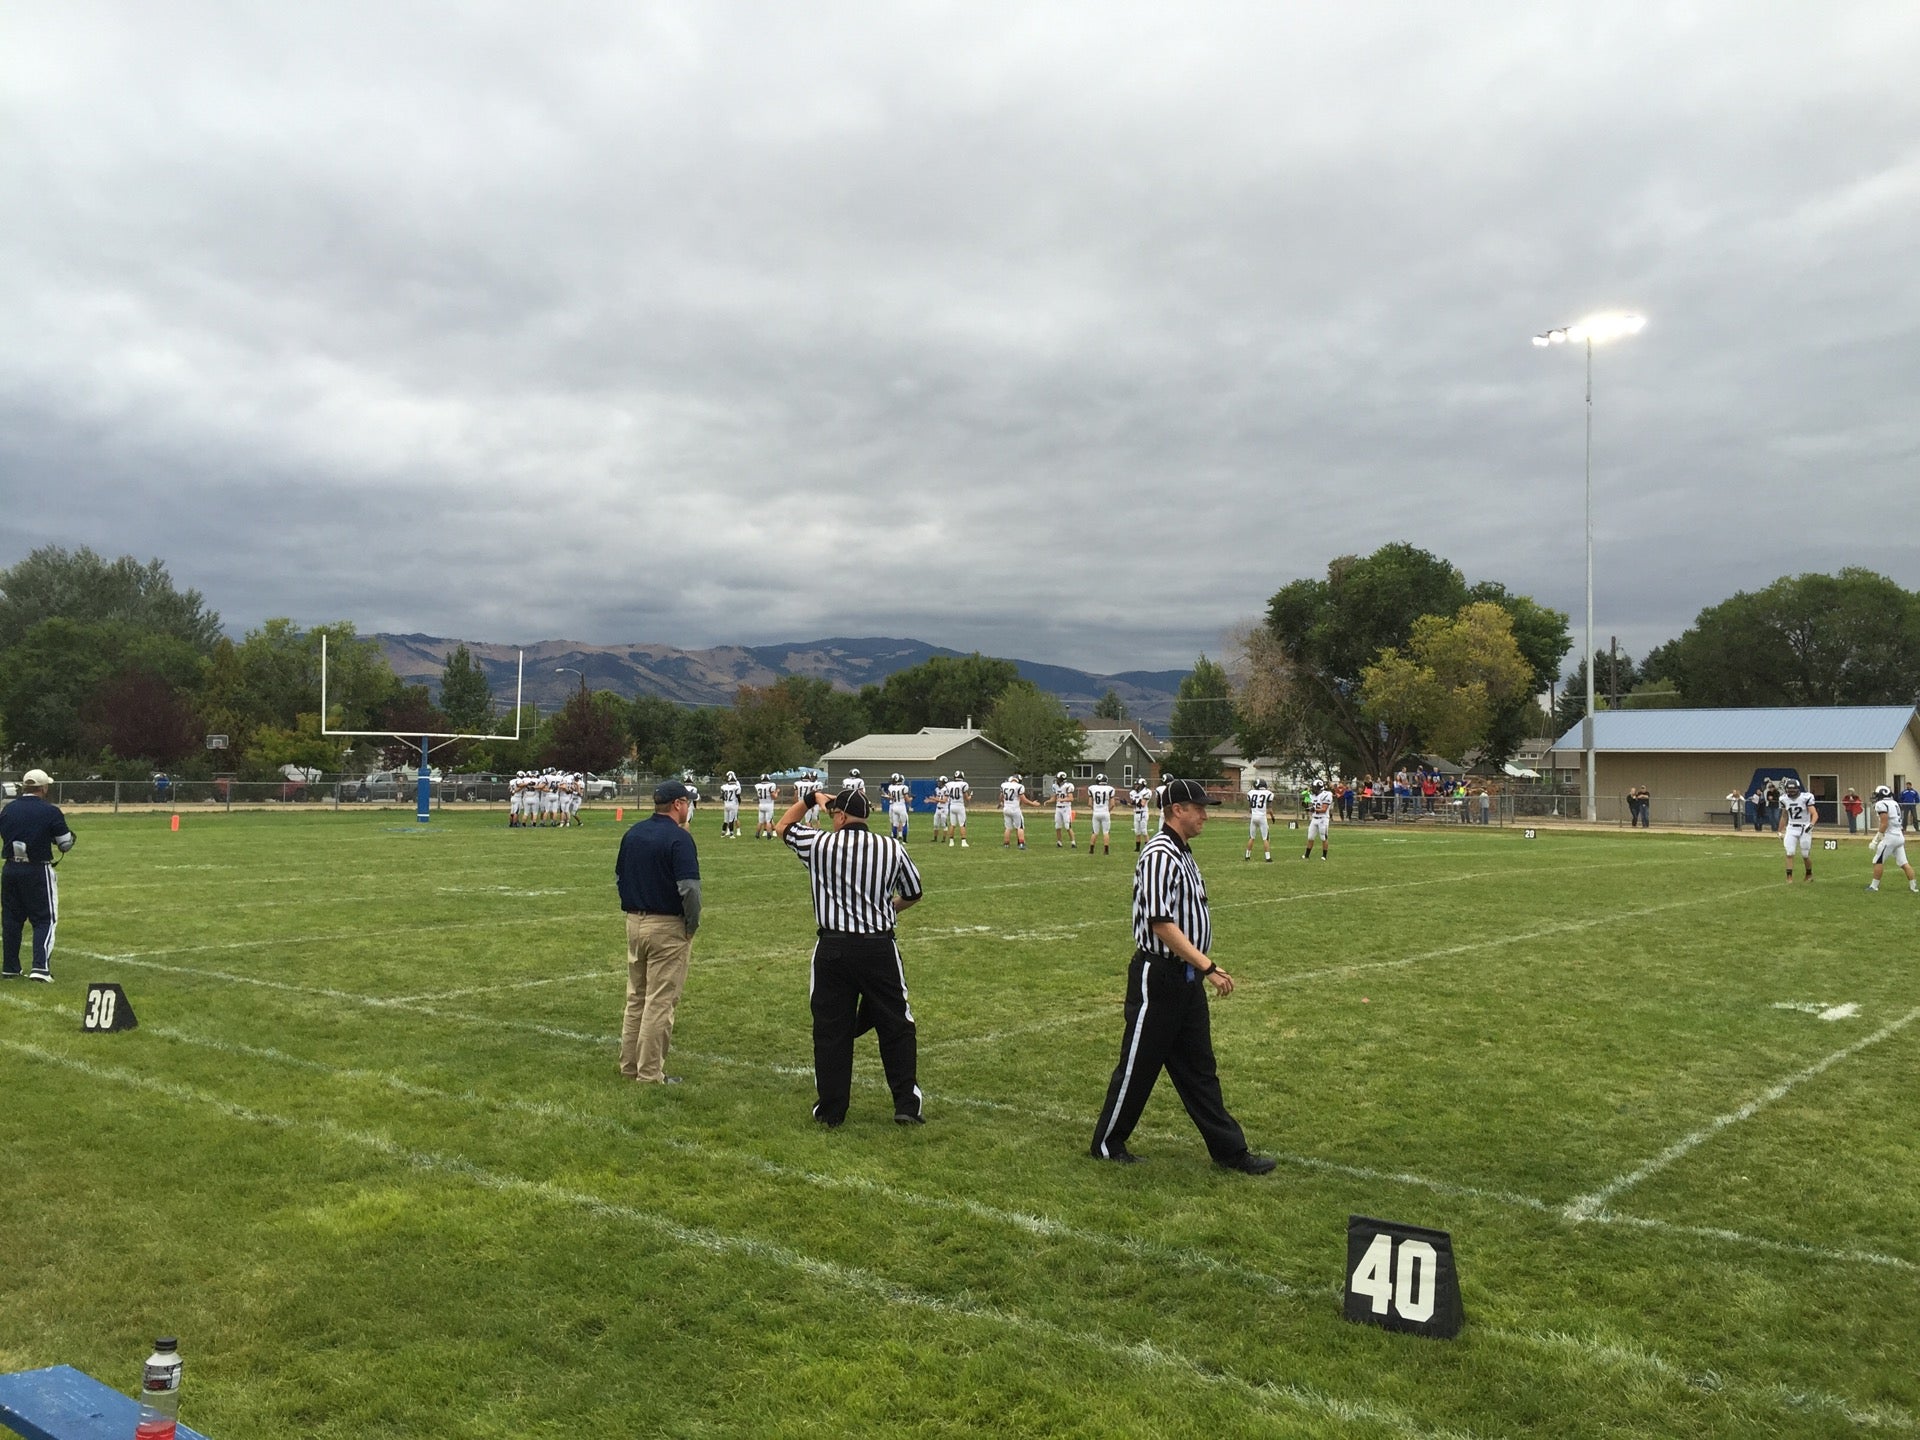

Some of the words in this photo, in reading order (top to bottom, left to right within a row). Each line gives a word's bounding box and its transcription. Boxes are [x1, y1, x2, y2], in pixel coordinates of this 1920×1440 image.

[757, 788, 767, 800] 31
[949, 787, 960, 800] 40
[1003, 788, 1015, 801] 52
[1095, 791, 1106, 804] 61
[1251, 794, 1266, 809] 83
[1788, 806, 1802, 820] 12
[1524, 829, 1535, 838] 20
[1825, 840, 1836, 850] 30
[86, 989, 116, 1028] 30
[1351, 1233, 1438, 1323] 40
